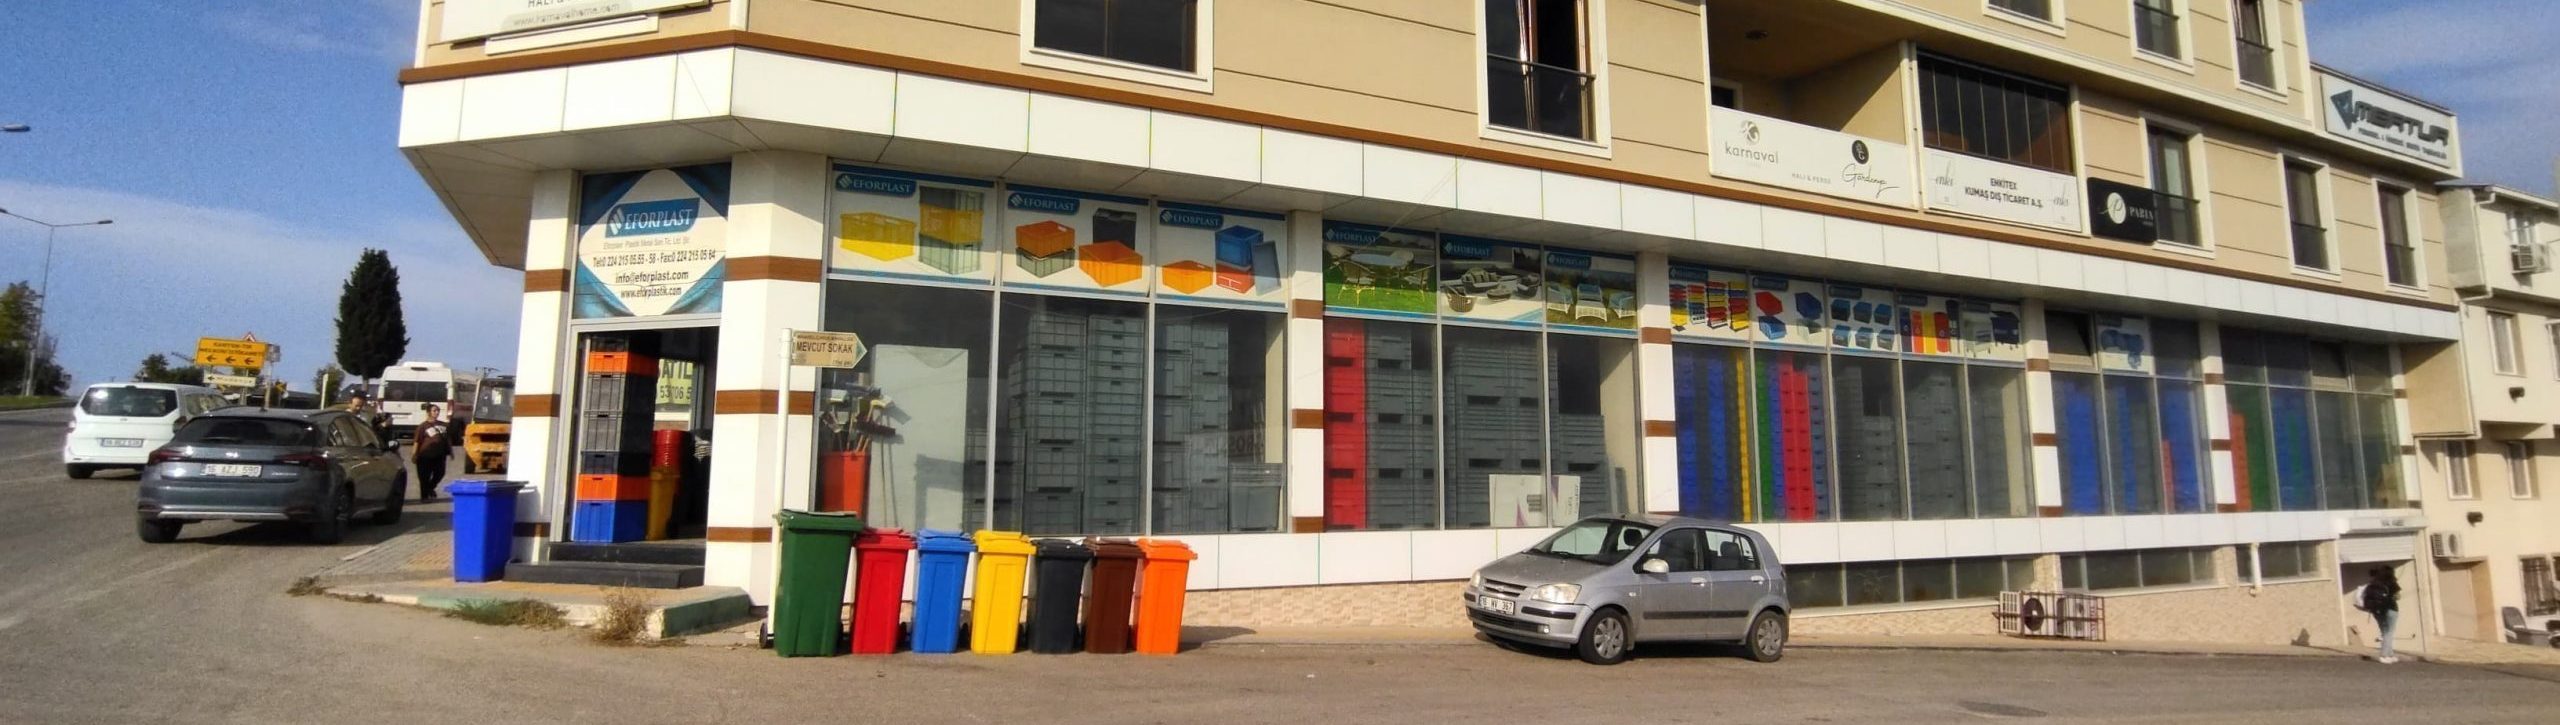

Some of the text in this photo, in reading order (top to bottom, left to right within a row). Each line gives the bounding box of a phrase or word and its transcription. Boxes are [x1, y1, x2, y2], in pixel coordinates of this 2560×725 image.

[1724, 141, 1779, 165] karnaval
[853, 179, 911, 193] EFORPLAST
[1023, 197, 1074, 211] EFORPLAST
[625, 209, 694, 230] EFORPLAST
[1173, 214, 1218, 226] EFORPLAST
[796, 341, 853, 354] MEVCUT SOKAK
